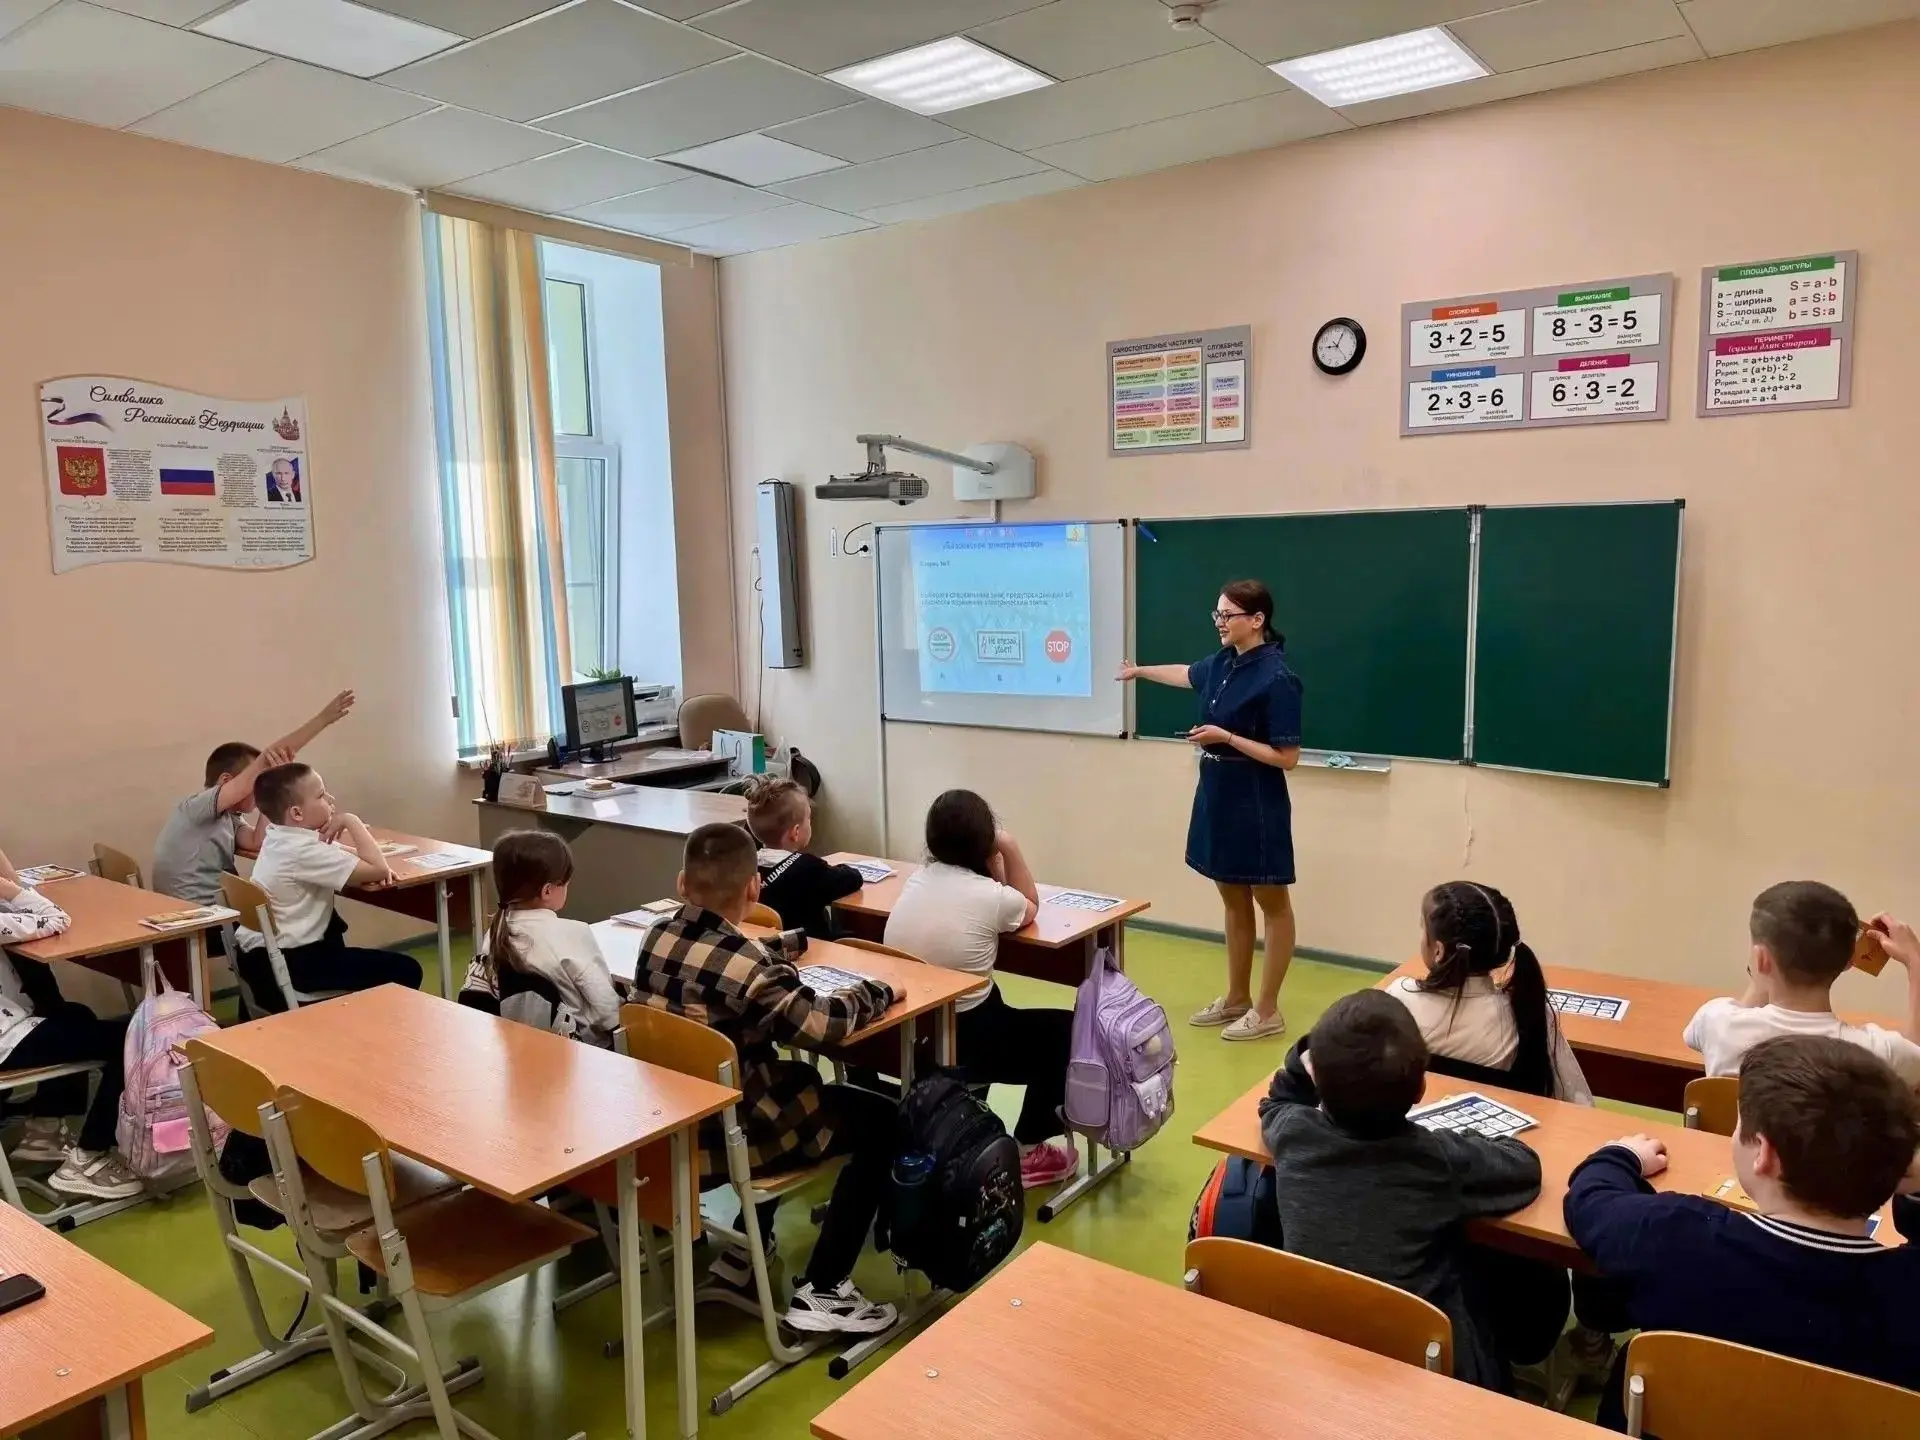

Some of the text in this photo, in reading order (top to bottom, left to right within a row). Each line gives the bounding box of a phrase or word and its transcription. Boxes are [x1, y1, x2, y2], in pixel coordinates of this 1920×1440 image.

[1740, 262, 1811, 276] ПЛОЩАДЬ ФИГУРЫ
[1790, 281, 1798, 290] S
[1575, 293, 1612, 301] ВЫЧИТАНИЕ
[1734, 288, 1763, 298] длина
[1735, 297, 1772, 306] ширина
[1735, 306, 1777, 316] площадь
[1789, 310, 1796, 319] b
[1553, 318, 1566, 336] 8
[1589, 314, 1602, 333] 3
[1623, 310, 1637, 329] 5
[1430, 331, 1442, 348] 3
[1460, 328, 1472, 345] 2
[1492, 324, 1504, 342] 5
[1755, 335, 1793, 343] ПЕРИМЕТР
[1113, 342, 1167, 353] САМОСТОЯТЕЛЬНЫЕ
[1207, 341, 1243, 350] СЛУЖЕБНЫЕ
[1553, 384, 1566, 401] 6
[1586, 381, 1600, 399] 3
[1621, 378, 1634, 397] 2
[90, 386, 164, 405] Символика
[1428, 394, 1440, 410] 2
[1459, 391, 1471, 408] 3
[1491, 389, 1503, 406] 6
[124, 408, 265, 432] Российской Федерации
[1048, 641, 1068, 652] STOP
